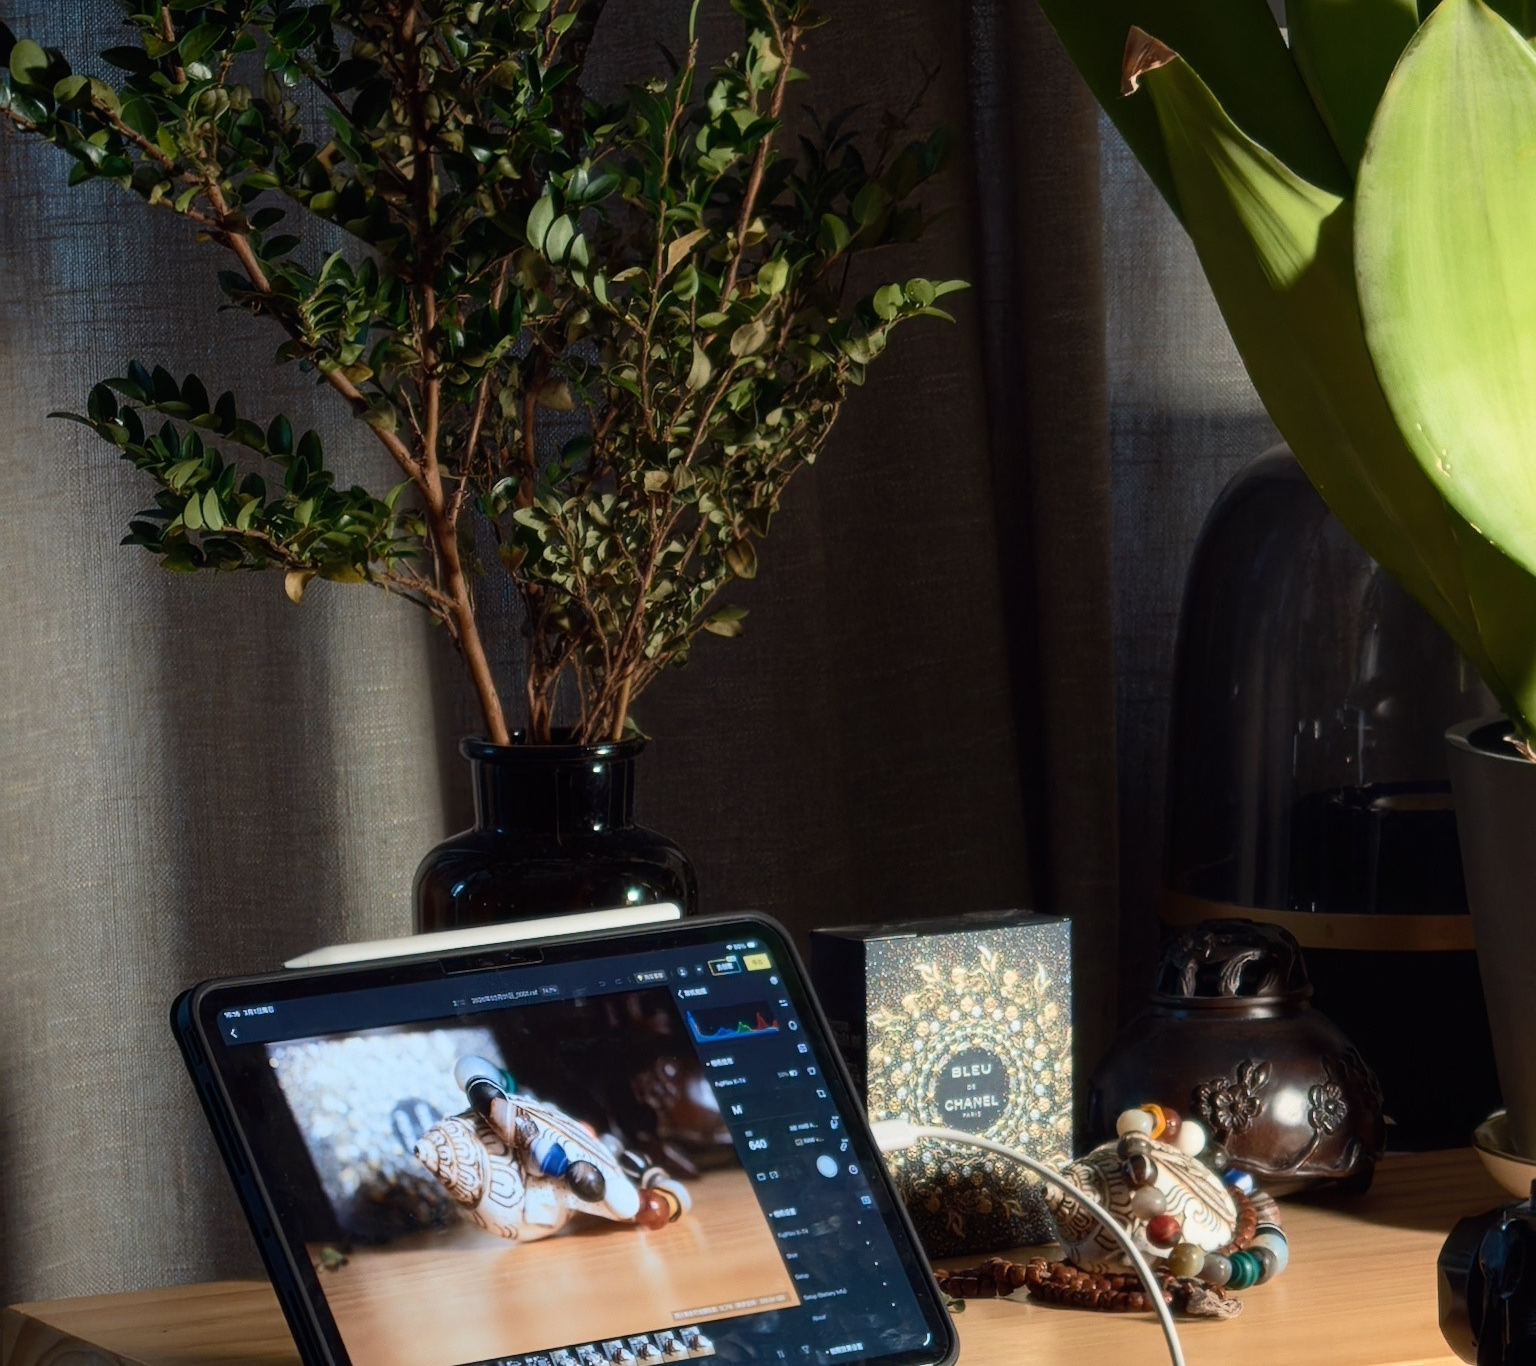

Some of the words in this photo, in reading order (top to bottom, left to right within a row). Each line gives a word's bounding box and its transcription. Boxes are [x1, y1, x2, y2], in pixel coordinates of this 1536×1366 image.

[952, 1063, 992, 1079] BLEU
[966, 1083, 976, 1091] DE
[731, 1104, 743, 1115] M
[944, 1095, 999, 1111] CHANEL
[748, 1138, 768, 1151] 640
